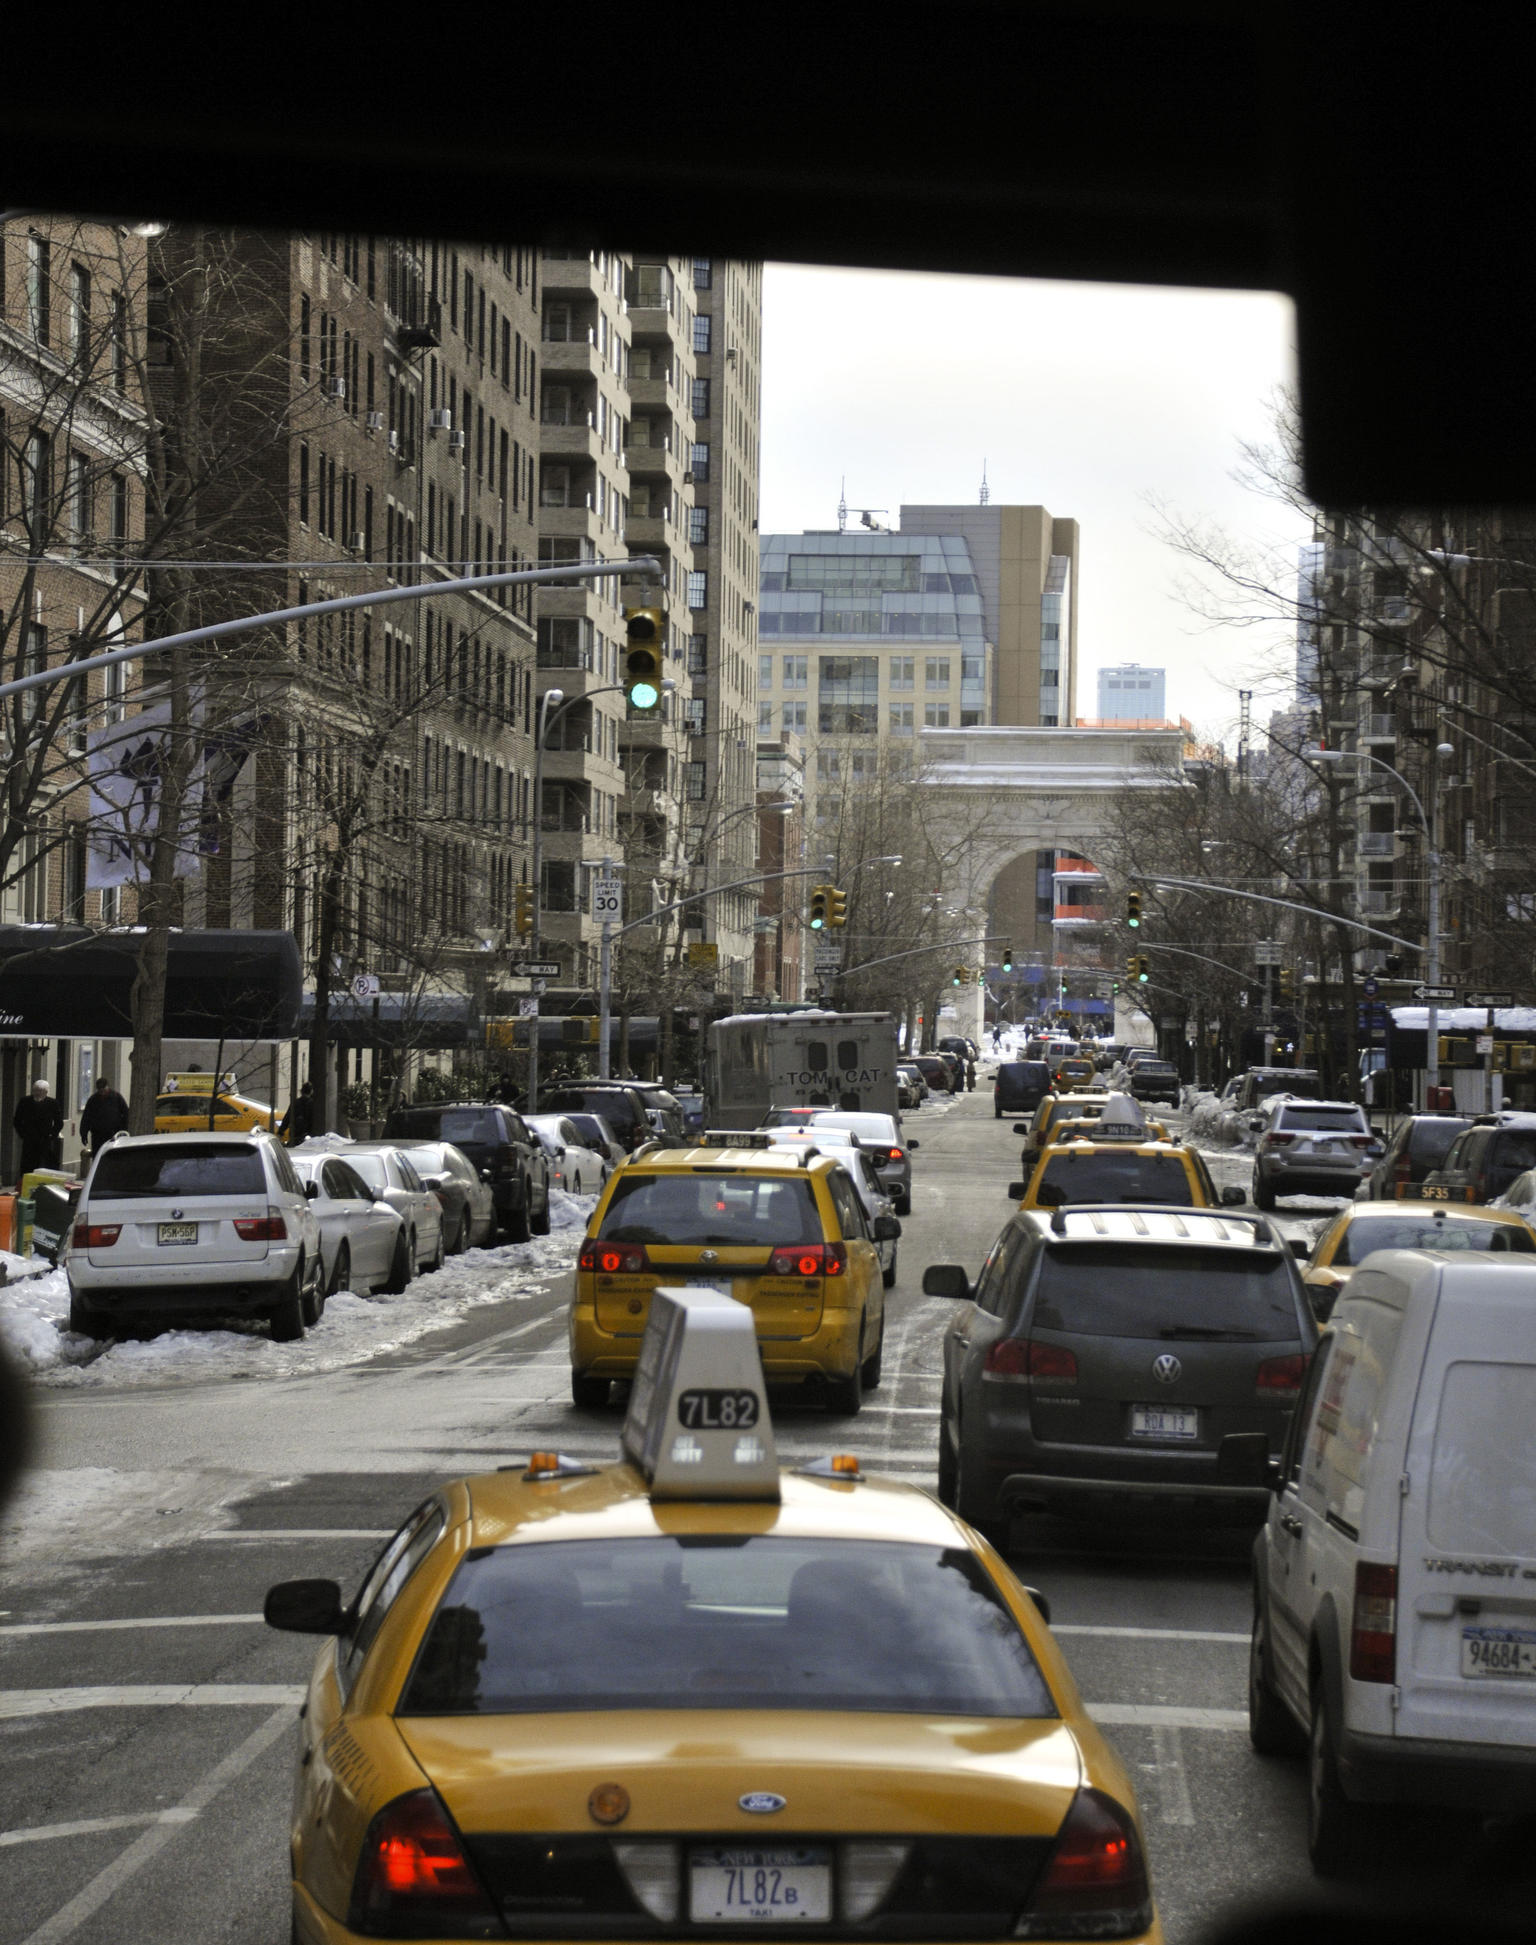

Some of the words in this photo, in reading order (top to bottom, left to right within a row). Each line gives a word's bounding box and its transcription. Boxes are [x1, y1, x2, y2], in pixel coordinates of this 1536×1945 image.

[596, 897, 618, 910] 30
[786, 1071, 828, 1085] TOM
[845, 1069, 881, 1083] CAT
[1421, 1186, 1449, 1200] 5F35
[683, 1395, 755, 1426] 7L82
[1422, 1558, 1519, 1578] TRANSIT
[750, 1908, 773, 1917] TAXI
